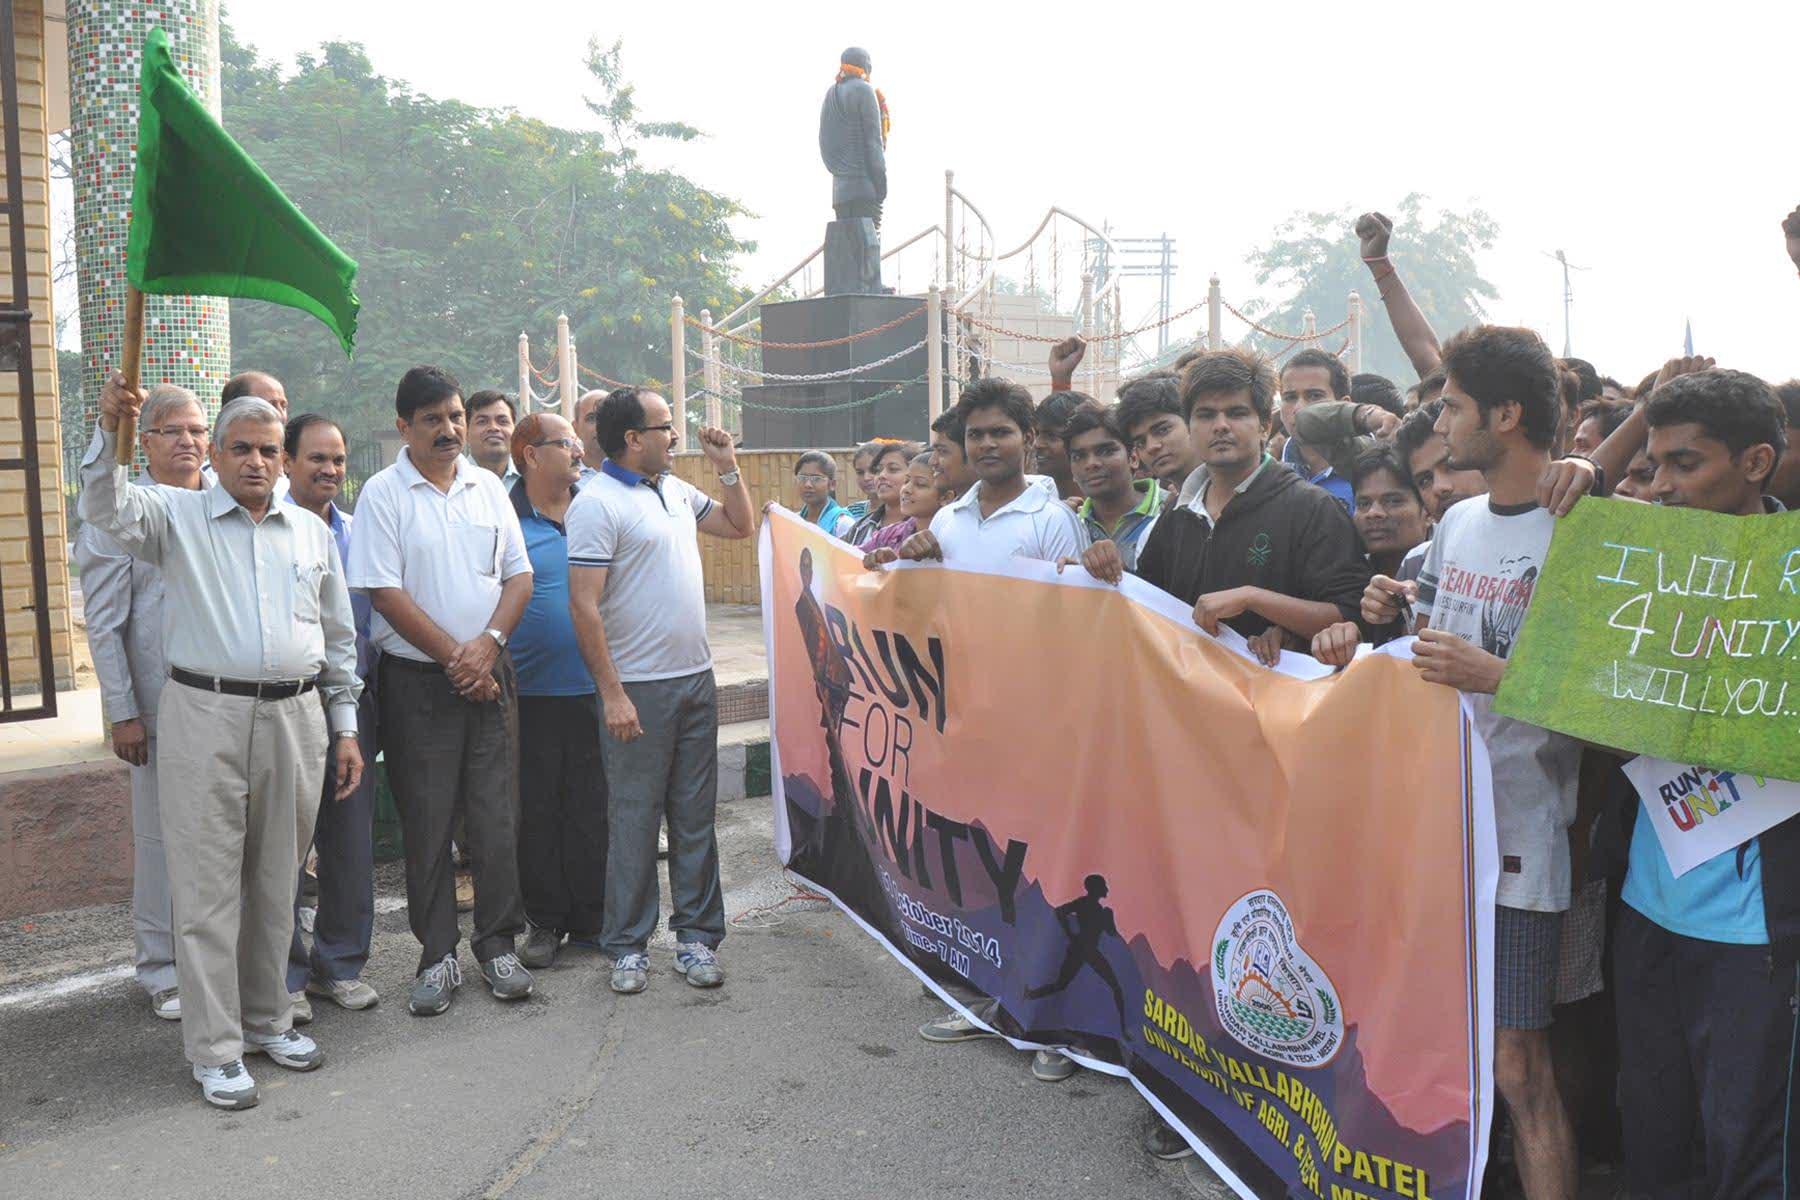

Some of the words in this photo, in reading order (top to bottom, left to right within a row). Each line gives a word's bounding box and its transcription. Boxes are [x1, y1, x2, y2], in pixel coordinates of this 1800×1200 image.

[1596, 542, 1653, 587] I
[1657, 552, 1758, 600] WILL
[1607, 591, 1655, 657] 4
[824, 602, 947, 736] RUN
[1613, 660, 1716, 713] WILL
[1659, 766, 1702, 806] RUN
[1667, 770, 1766, 833] UNIT
[937, 940, 948, 962] 7
[949, 947, 970, 979] AM
[953, 918, 1002, 969] 2014
[1142, 1024, 1229, 1095] UNIVERSITY
[1231, 1087, 1255, 1111] OF
[1257, 1099, 1290, 1149] AGRI.
[1293, 1133, 1305, 1161] &
[1143, 988, 1212, 1064] SARDAR
[1211, 1047, 1338, 1162] VALLABHBHAI
[1333, 1140, 1433, 1200] PATEL
